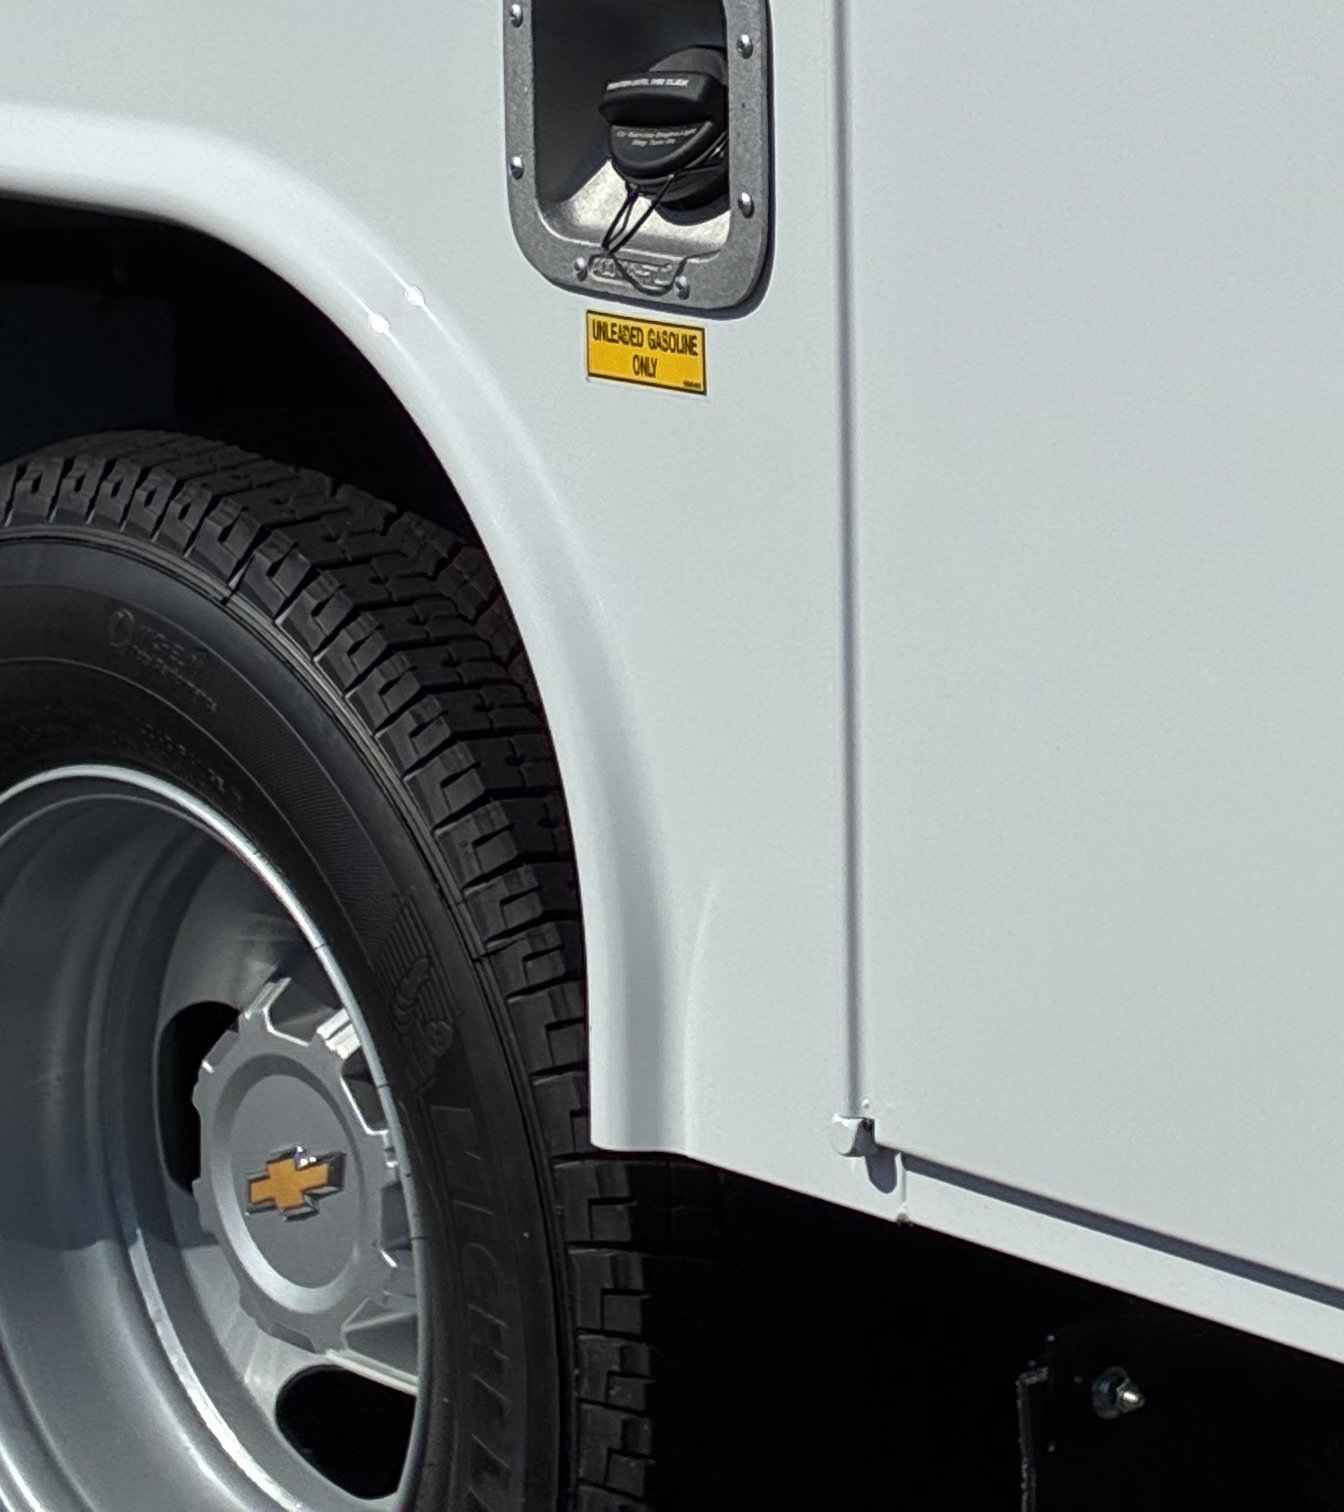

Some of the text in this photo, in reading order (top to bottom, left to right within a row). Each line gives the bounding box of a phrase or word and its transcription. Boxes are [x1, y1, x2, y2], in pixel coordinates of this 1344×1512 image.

[592, 319, 699, 357] UNLEADED GASOLINE
[632, 354, 658, 378] ONLY
[434, 1104, 516, 1512] MICHEL
